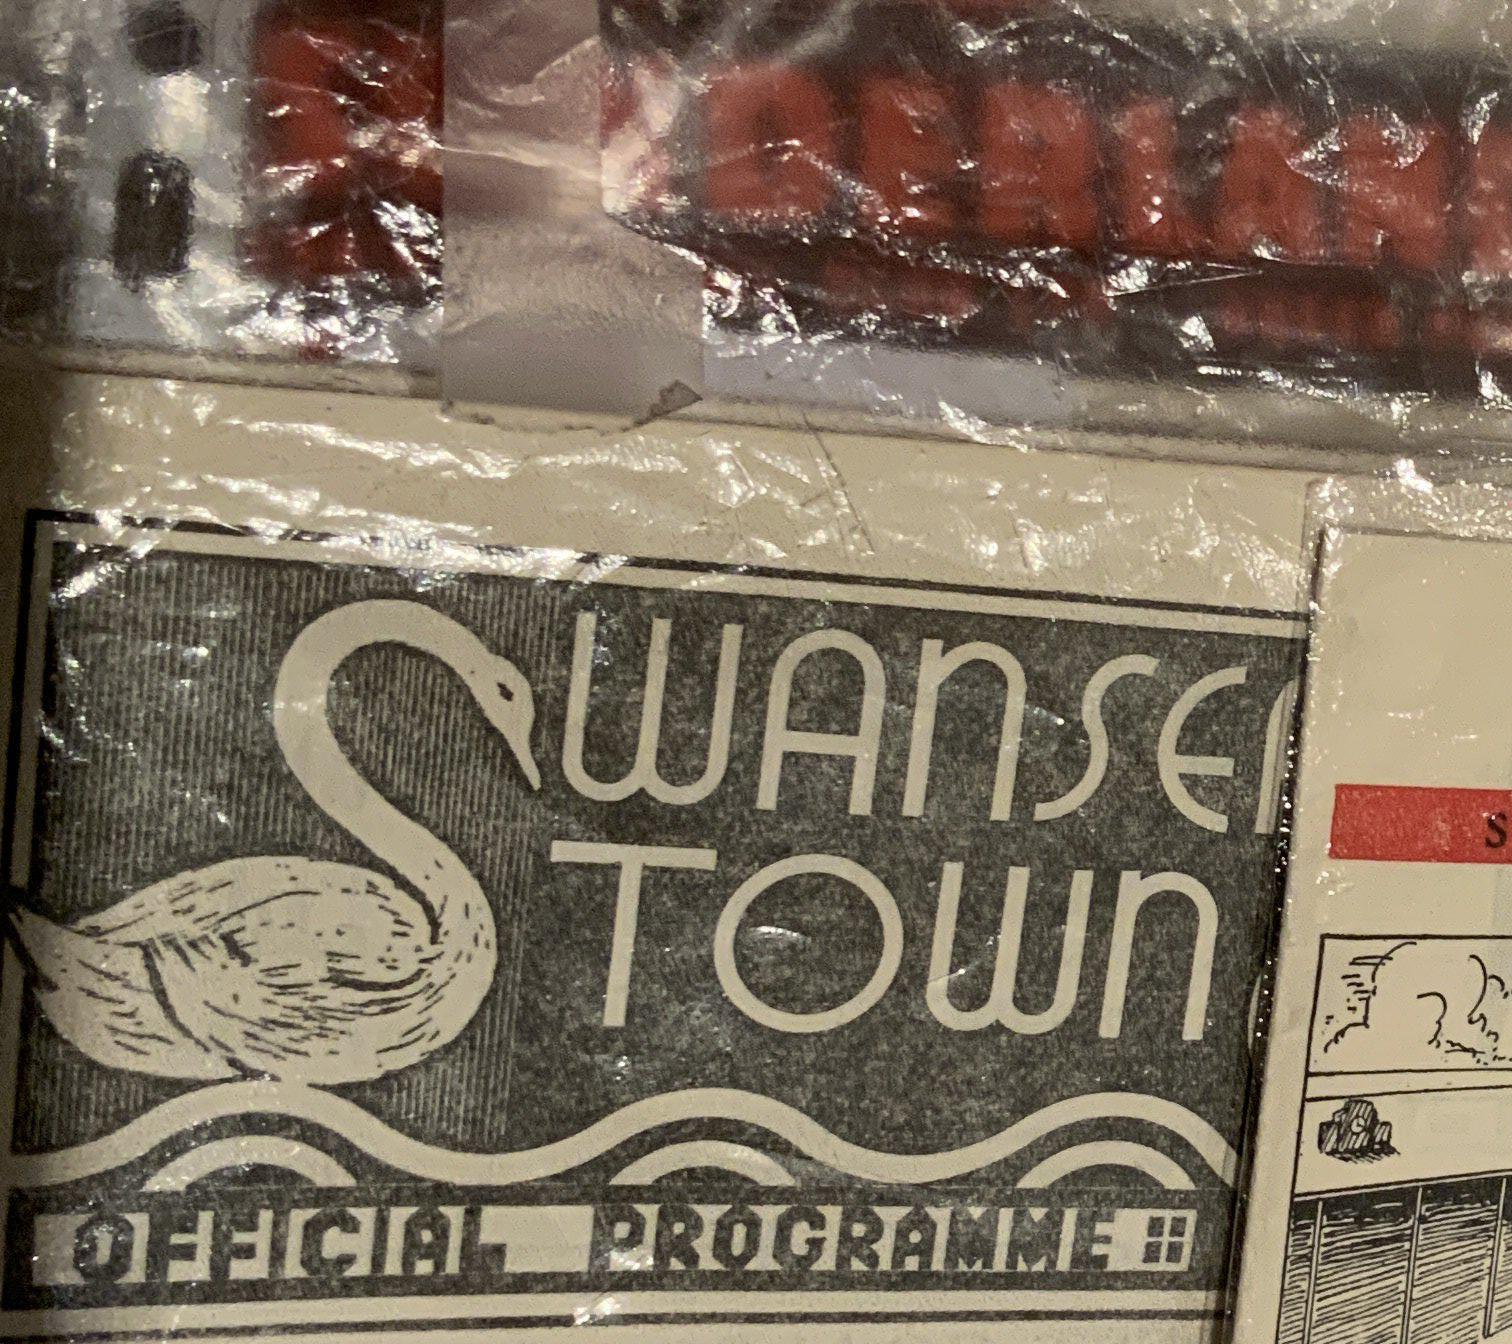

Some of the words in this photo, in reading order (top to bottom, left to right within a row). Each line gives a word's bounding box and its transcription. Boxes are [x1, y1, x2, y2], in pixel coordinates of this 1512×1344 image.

[551, 838, 1219, 1042] TOWN
[73, 1206, 507, 1286] OFFICIAL
[596, 1202, 1122, 1273] PROGRAMME
